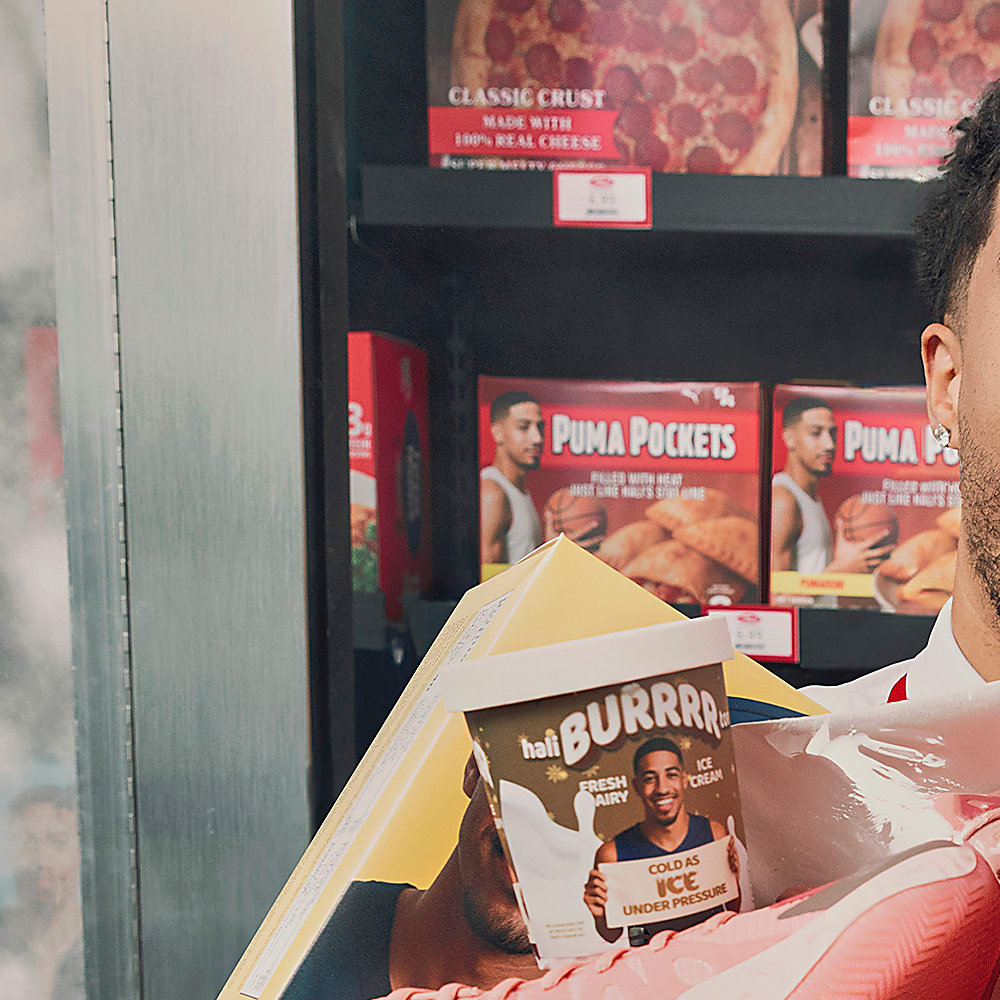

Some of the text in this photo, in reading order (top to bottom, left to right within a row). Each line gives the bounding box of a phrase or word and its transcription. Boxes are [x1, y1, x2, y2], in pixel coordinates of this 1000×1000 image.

[448, 86, 607, 109] CLASSIC CRUST
[868, 95, 960, 118] CLASSIC
[482, 115, 573, 131] MADE WITH
[495, 133, 535, 148] REAL
[538, 134, 602, 150] CHEESE
[551, 413, 737, 460] PUMA POCKETS
[843, 419, 920, 466] PUMA
[696, 756, 714, 772] ICE
[579, 774, 628, 794] FRESH
[688, 768, 724, 789] CREAM
[594, 789, 630, 808] AIRY
[648, 854, 700, 876] COLD AS
[655, 871, 700, 899] ICE
[622, 883, 728, 917] UNDER PRESSURE
